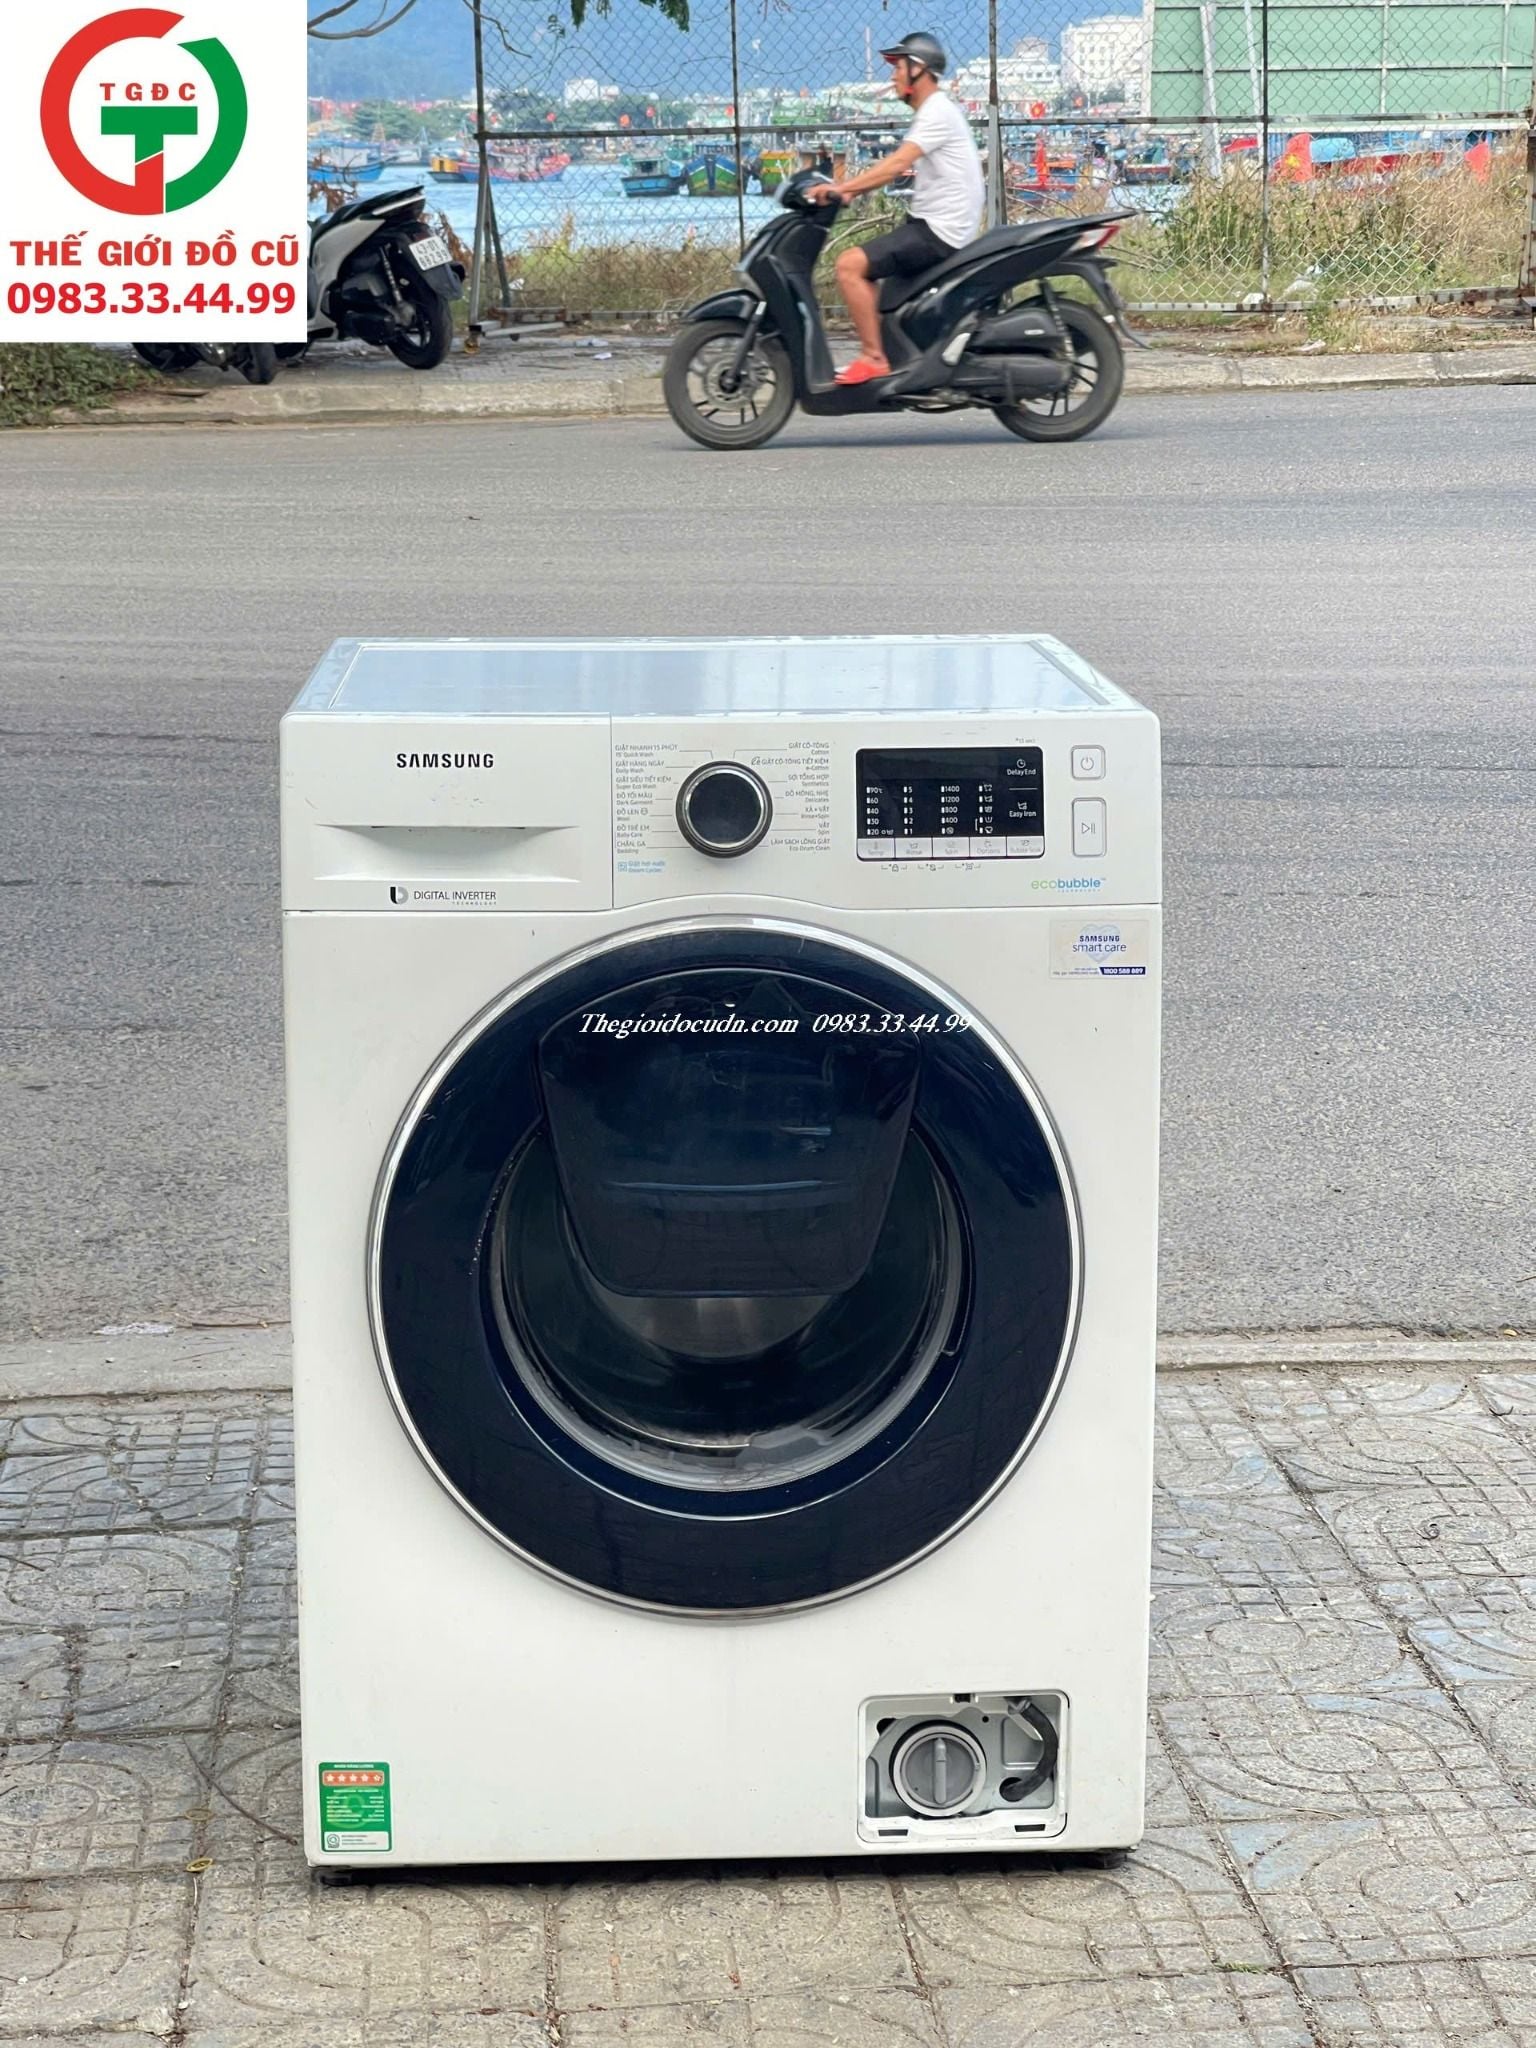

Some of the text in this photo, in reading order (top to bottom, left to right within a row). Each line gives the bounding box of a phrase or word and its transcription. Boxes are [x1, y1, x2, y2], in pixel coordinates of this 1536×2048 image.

[396, 753, 495, 769] SAMSUNG
[414, 890, 497, 900] DIGITAL INVERTER
[1072, 944, 1127, 952] smart care
